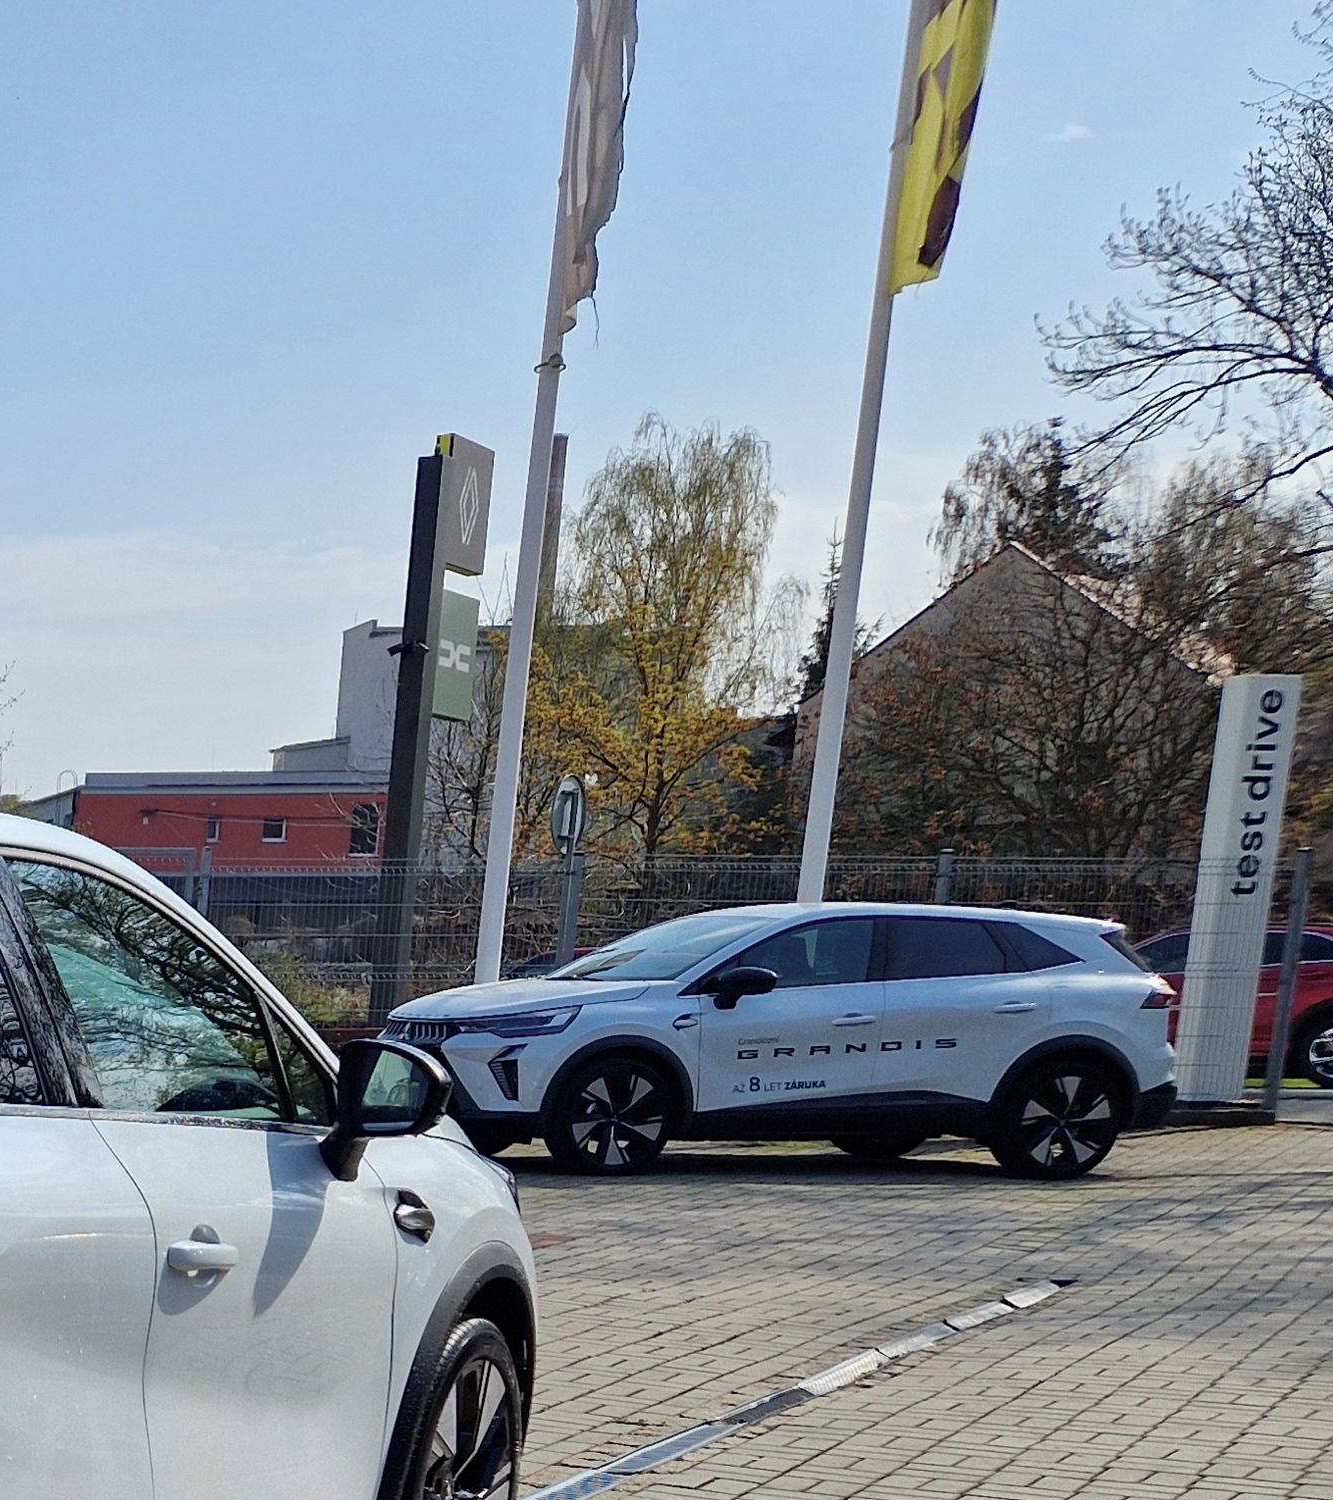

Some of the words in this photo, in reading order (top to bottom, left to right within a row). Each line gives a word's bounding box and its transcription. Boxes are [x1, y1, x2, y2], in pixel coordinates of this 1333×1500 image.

[1241, 688, 1284, 801] drive
[1231, 811, 1267, 898] test
[737, 1038, 958, 1060] GRANDIS
[749, 1076, 761, 1092] 8
[764, 1081, 782, 1092] LET
[784, 1079, 827, 1091] ZÁRUKA
